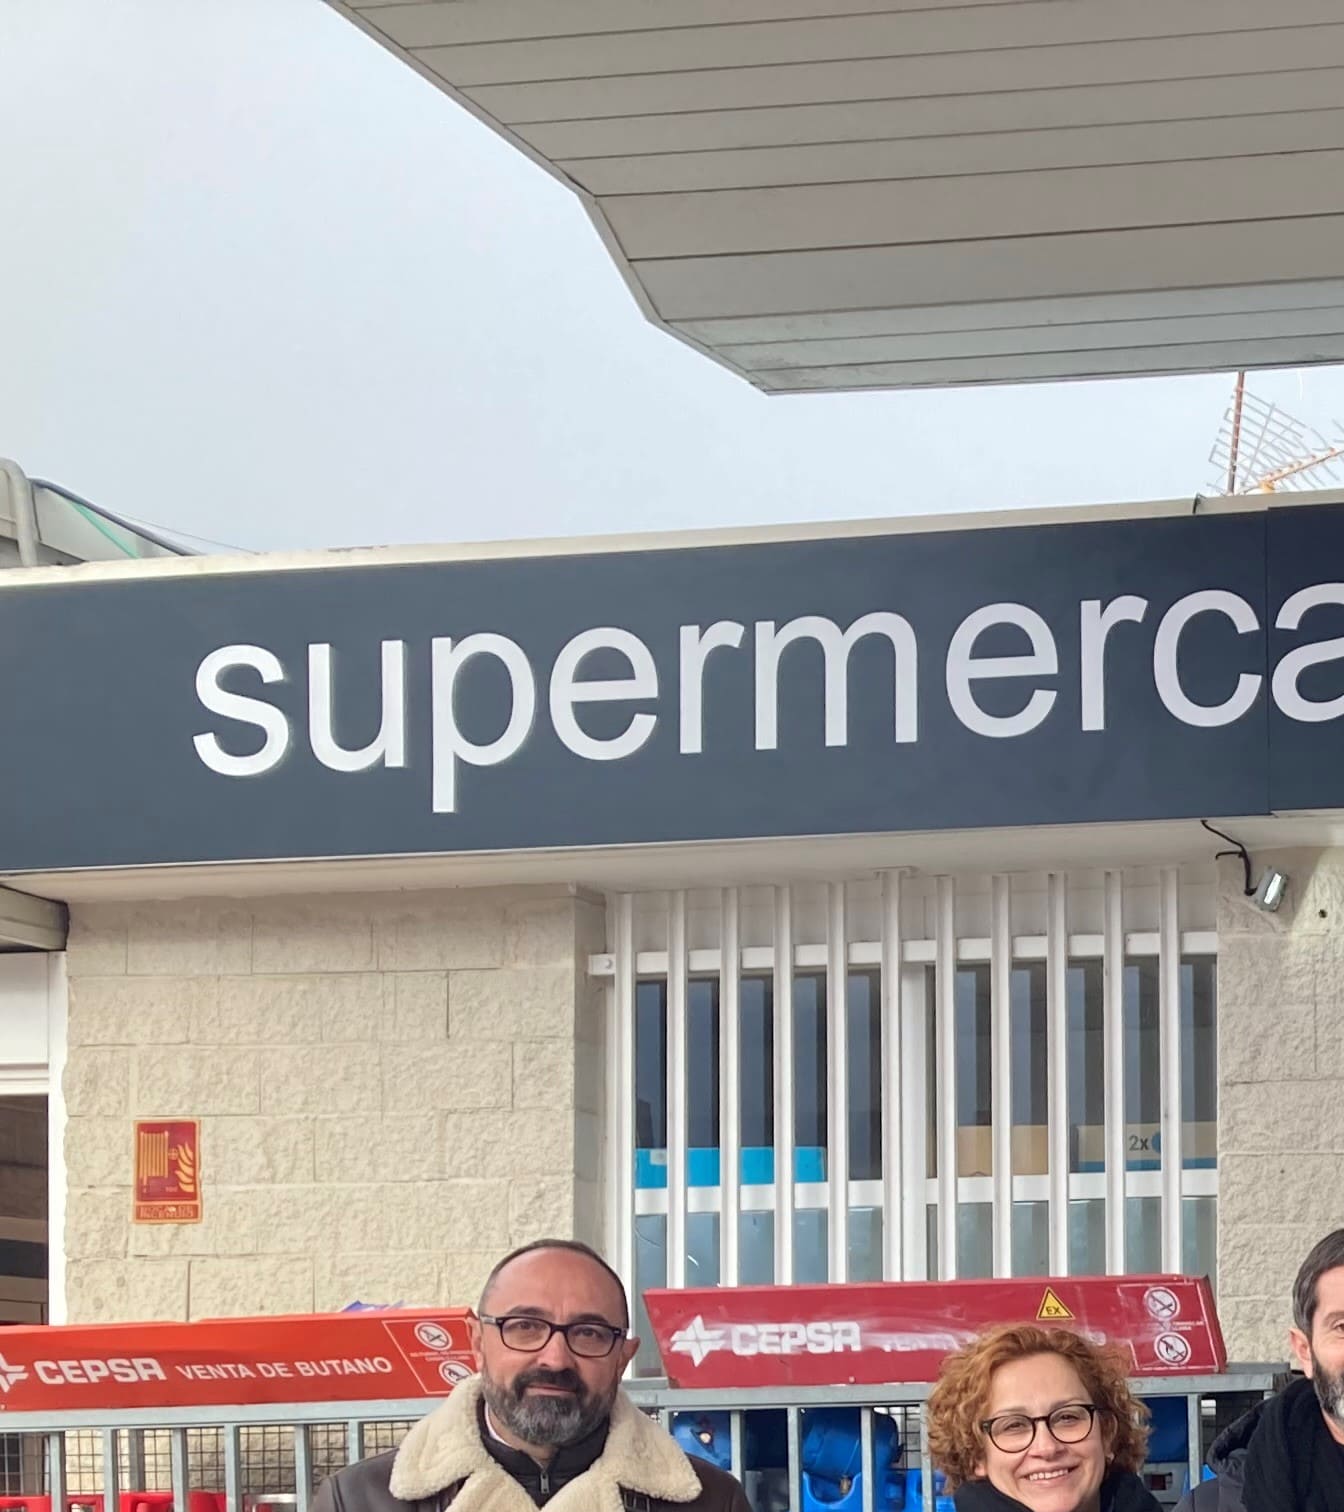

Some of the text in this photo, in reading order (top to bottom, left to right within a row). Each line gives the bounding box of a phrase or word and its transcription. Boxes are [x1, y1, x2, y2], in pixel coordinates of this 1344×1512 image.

[1045, 1305, 1061, 1316] EX
[729, 1321, 861, 1356] CEPSA
[36, 1358, 167, 1385] CEPSA
[176, 1361, 256, 1381] VENTA
[261, 1360, 294, 1379] DE
[298, 1355, 393, 1378] BUTANO
